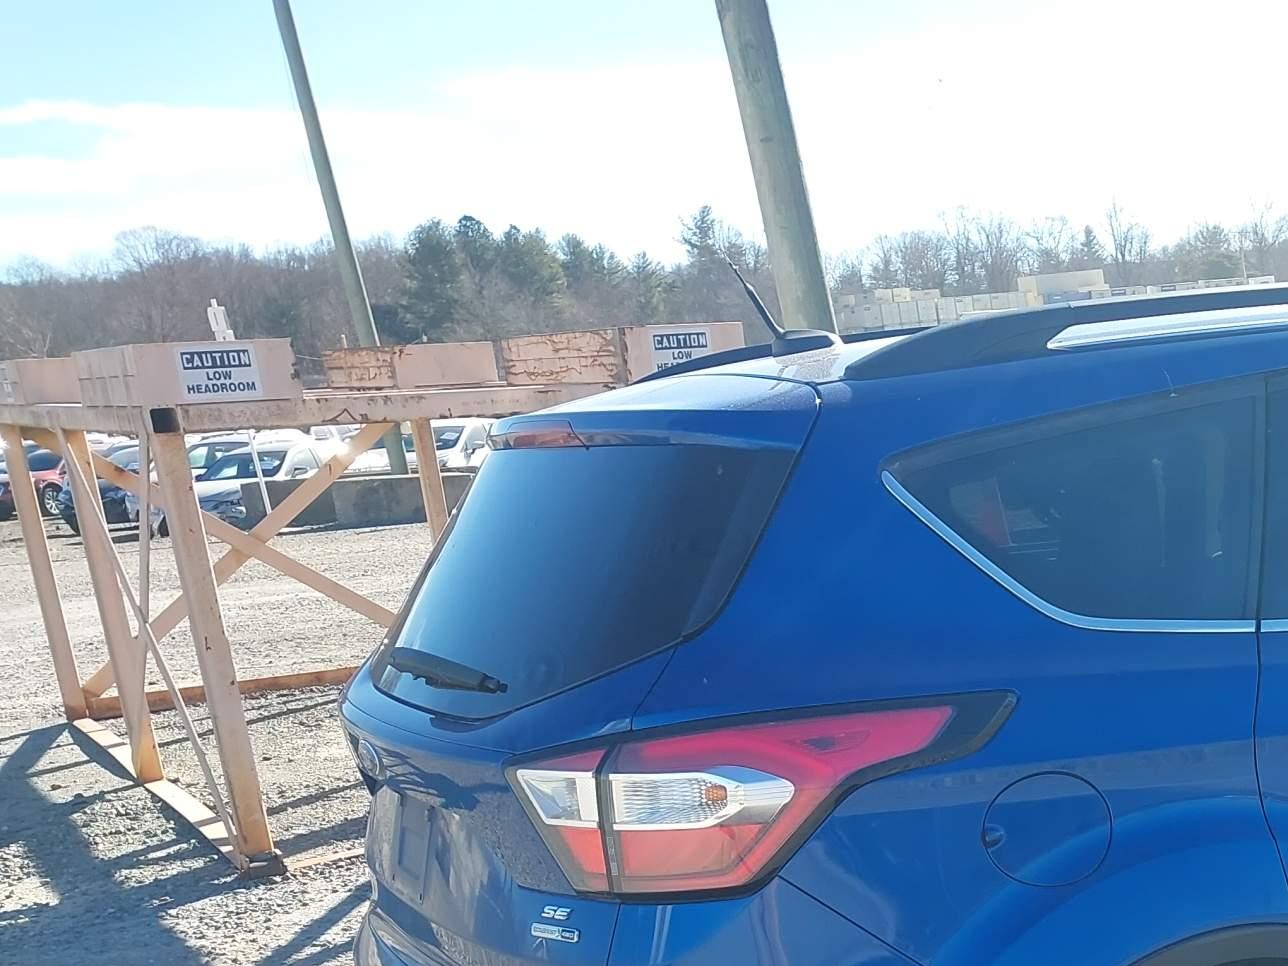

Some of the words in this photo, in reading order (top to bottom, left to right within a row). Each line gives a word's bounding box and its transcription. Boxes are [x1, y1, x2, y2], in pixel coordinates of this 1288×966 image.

[654, 334, 706, 349] CAUTION
[182, 351, 250, 369] CAUTION
[672, 350, 693, 360] LOW
[206, 370, 232, 381] LOW
[187, 381, 257, 394] HEADROOM
[541, 905, 571, 920] SE
